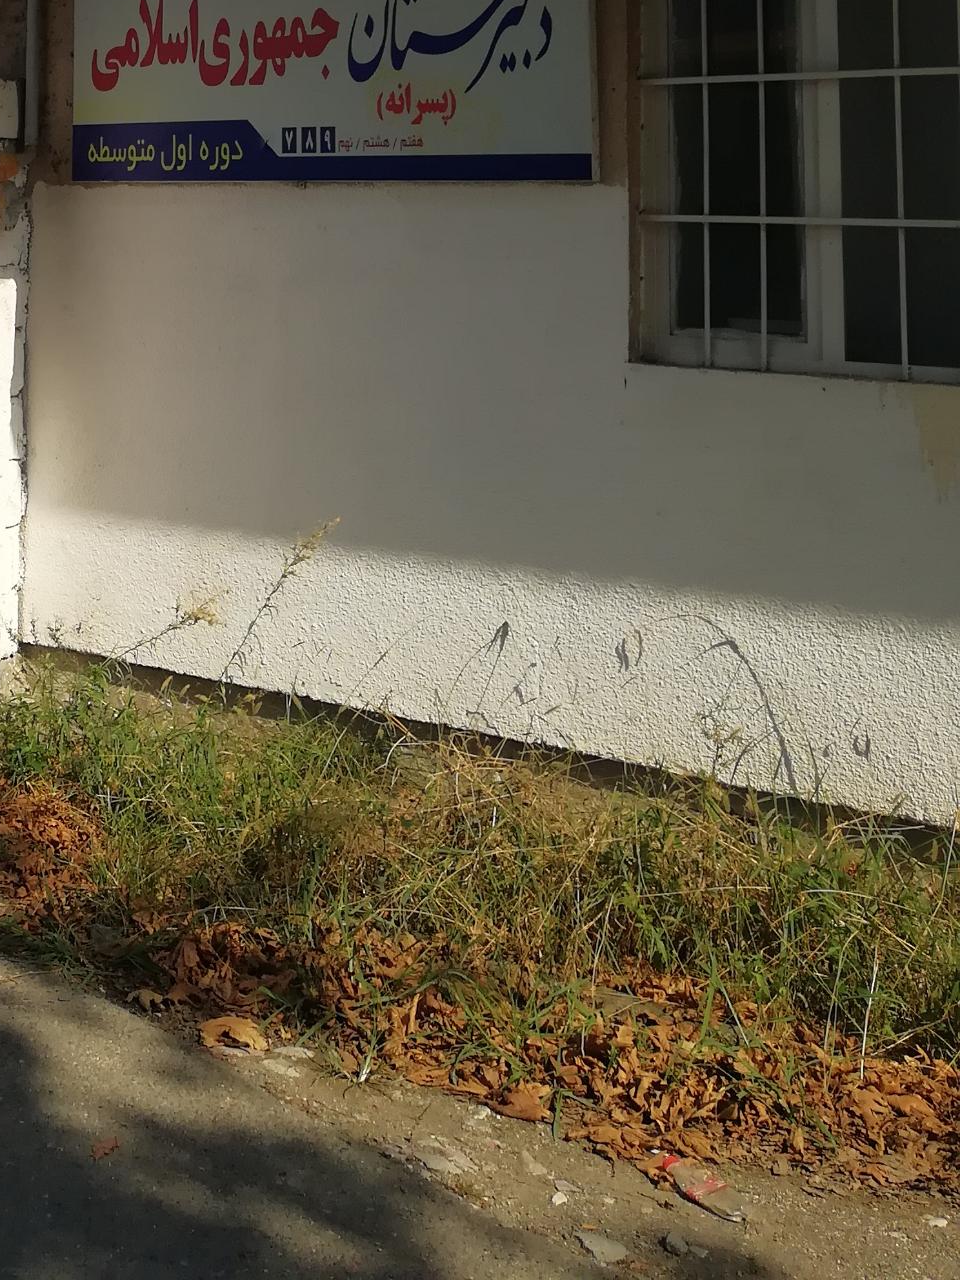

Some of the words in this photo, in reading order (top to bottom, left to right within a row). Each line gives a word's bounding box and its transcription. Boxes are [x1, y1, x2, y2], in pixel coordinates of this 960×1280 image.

[198, 7, 340, 87] جمهوری
[376, 82, 457, 126] (پسرانه)
[87, 136, 155, 172] متوسطه
[160, 134, 192, 172] اول
[198, 138, 244, 171] دوره
[338, 136, 353, 152] نهم
[362, 135, 390, 152] هشتم
[400, 134, 424, 152] هفتم
